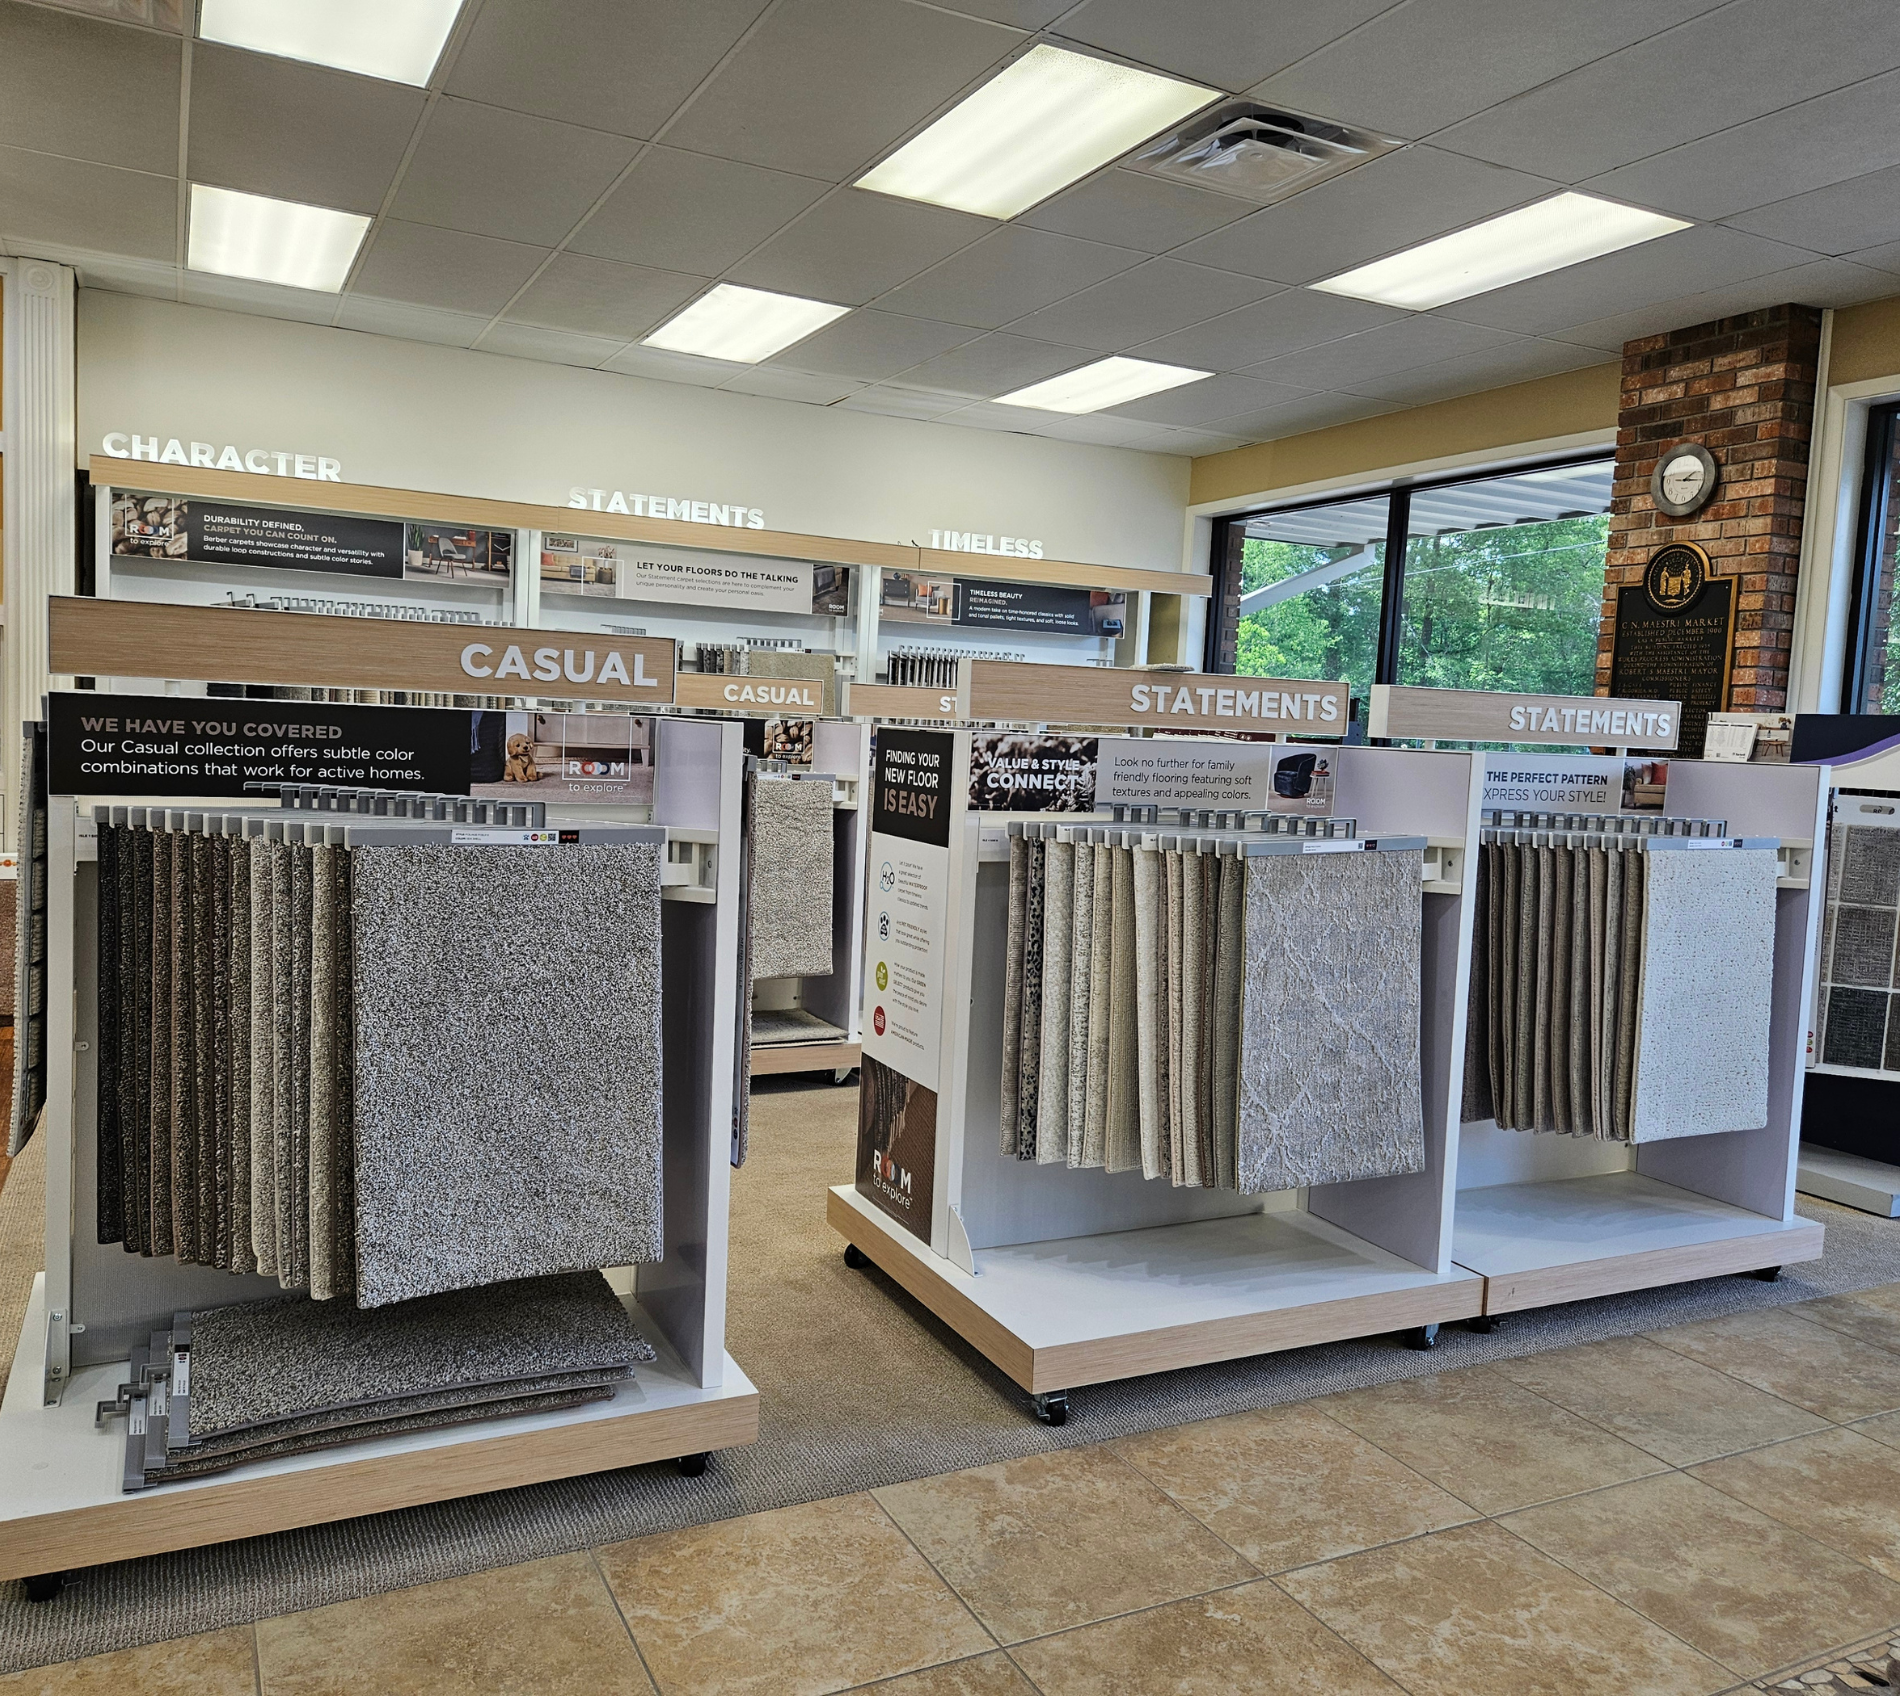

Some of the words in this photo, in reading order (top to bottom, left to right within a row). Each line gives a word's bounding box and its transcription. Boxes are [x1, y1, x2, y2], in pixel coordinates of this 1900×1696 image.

[102, 432, 342, 482] CHARACTER
[568, 486, 764, 529] STATEMENTS
[130, 524, 170, 536] ROOM
[204, 515, 260, 526] DURABILITY
[262, 520, 304, 532] DEFINED,
[204, 524, 241, 534] CARPET
[243, 528, 263, 536] YOU
[265, 530, 285, 538] CAN
[287, 532, 319, 541] COUNT
[928, 528, 1043, 560] TIMELESS
[248, 549, 294, 558] constructions
[657, 564, 683, 572] YOUR
[686, 566, 723, 576] FLOORS
[725, 570, 738, 578] DO
[741, 572, 758, 580] THE
[760, 573, 798, 583] TALKING
[1642, 619, 1680, 628] MAESTRI
[1685, 617, 1725, 627] MARKET
[460, 643, 658, 687] CASUAL
[723, 684, 815, 706] CASUAL
[1130, 684, 1339, 722] STATEMENTS
[81, 717, 119, 732] WE
[126, 719, 185, 734] HAVE
[192, 721, 236, 736] YOU
[243, 723, 342, 738] COVERED
[1509, 706, 1672, 737] STATEMENTS
[81, 739, 116, 752] Our
[121, 740, 178, 754] Casual
[185, 743, 265, 756] collection
[271, 744, 318, 758] offers
[323, 747, 371, 759] subtle
[376, 748, 415, 760] color
[776, 743, 803, 751] ROOM
[886, 750, 916, 764] FINDING
[918, 753, 940, 767] YOUR
[988, 758, 1028, 769] VALUE
[1031, 759, 1040, 769] &
[1042, 759, 1080, 770] STYLE
[1115, 757, 1139, 767] Look
[1142, 759, 1154, 768] no
[1157, 758, 1189, 768] further
[1192, 759, 1205, 769] for
[1208, 760, 1235, 772] family
[81, 761, 199, 774] combinations
[204, 763, 238, 776] that
[244, 764, 284, 776] work
[290, 764, 313, 777] for
[318, 766, 365, 778] active
[370, 767, 424, 780] homes.
[569, 762, 625, 776] ROOM
[885, 768, 906, 783] NEW
[908, 770, 939, 788] FLOOR
[986, 772, 1080, 790] CONNECT
[1114, 771, 1150, 784] friendly
[1153, 773, 1189, 785] flooring
[1192, 774, 1232, 786] featuring
[1235, 775, 1252, 785] soft
[1487, 771, 1508, 782] THE
[1511, 772, 1559, 783] PERFECT
[1561, 774, 1608, 785] PATTERN
[568, 783, 580, 792] to
[1113, 788, 1151, 797] textures
[1153, 788, 1172, 797] and
[1174, 789, 1219, 800] appealing
[1222, 790, 1251, 799] colors.
[884, 788, 897, 812] IS
[899, 791, 938, 818] EASY
[1533, 790, 1566, 802] YOUR
[1568, 790, 1607, 803] STYLE!
[873, 1172, 880, 1188] to
[874, 1149, 912, 1194] ROOM
